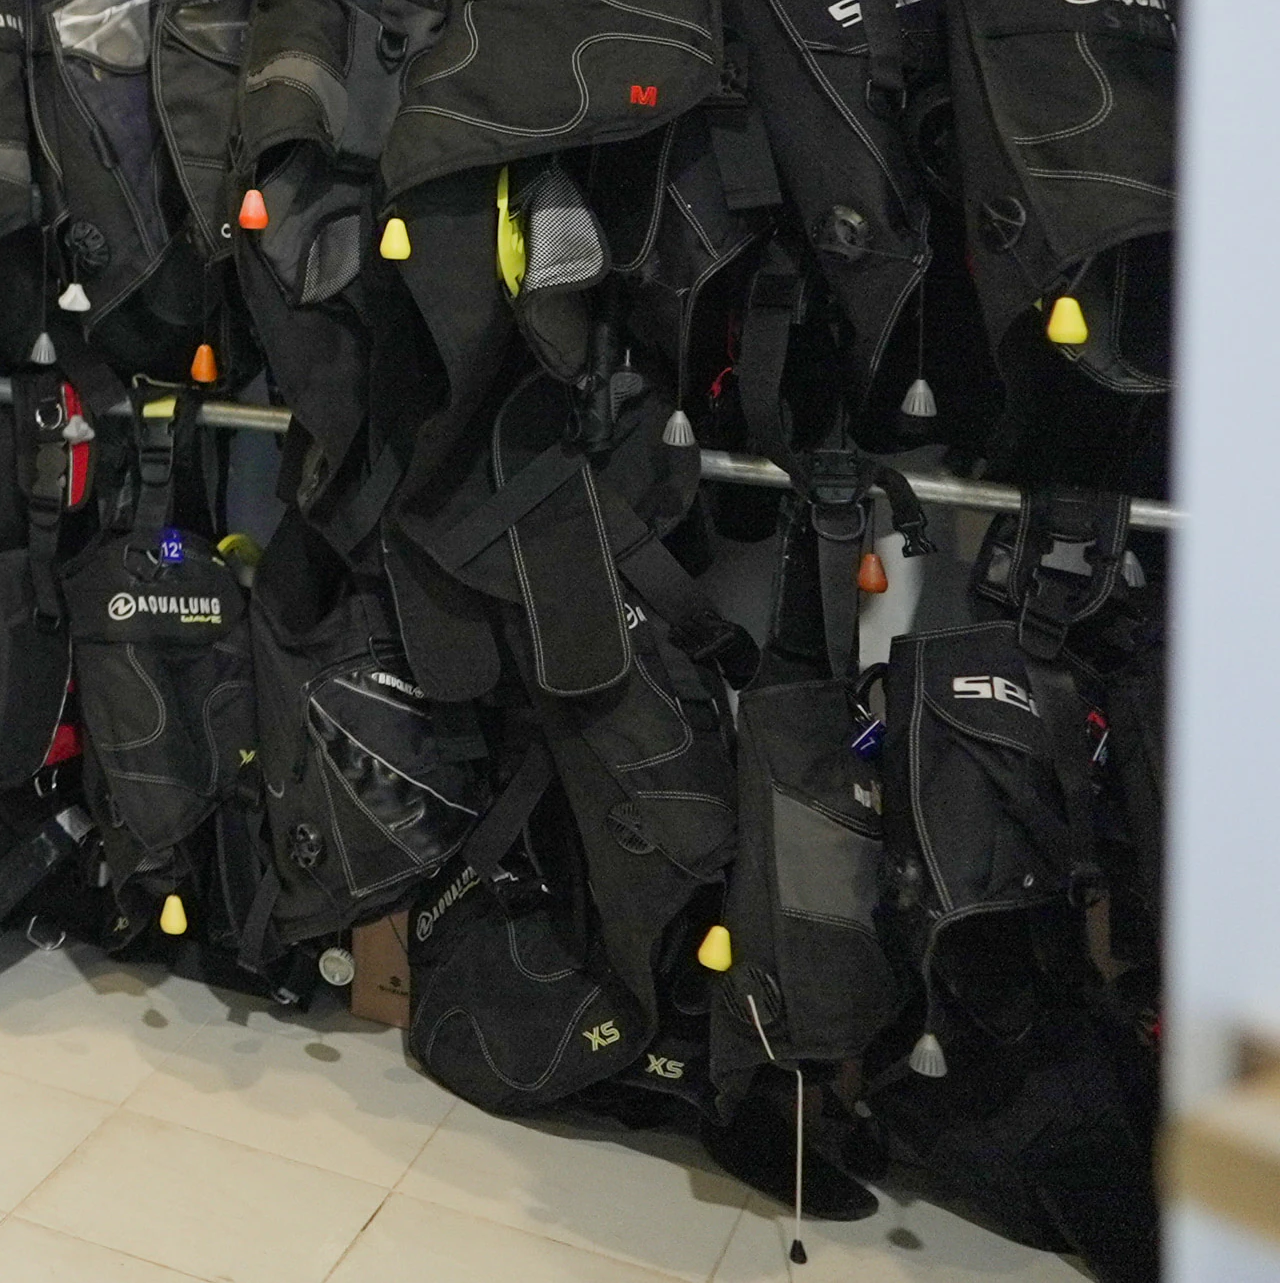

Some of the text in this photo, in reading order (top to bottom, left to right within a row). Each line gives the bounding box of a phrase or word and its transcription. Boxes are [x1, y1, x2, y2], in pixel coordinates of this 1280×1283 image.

[630, 85, 658, 107] M
[137, 594, 222, 615] AQUALUNG
[581, 1019, 621, 1052] XS
[645, 1053, 685, 1079] XS
